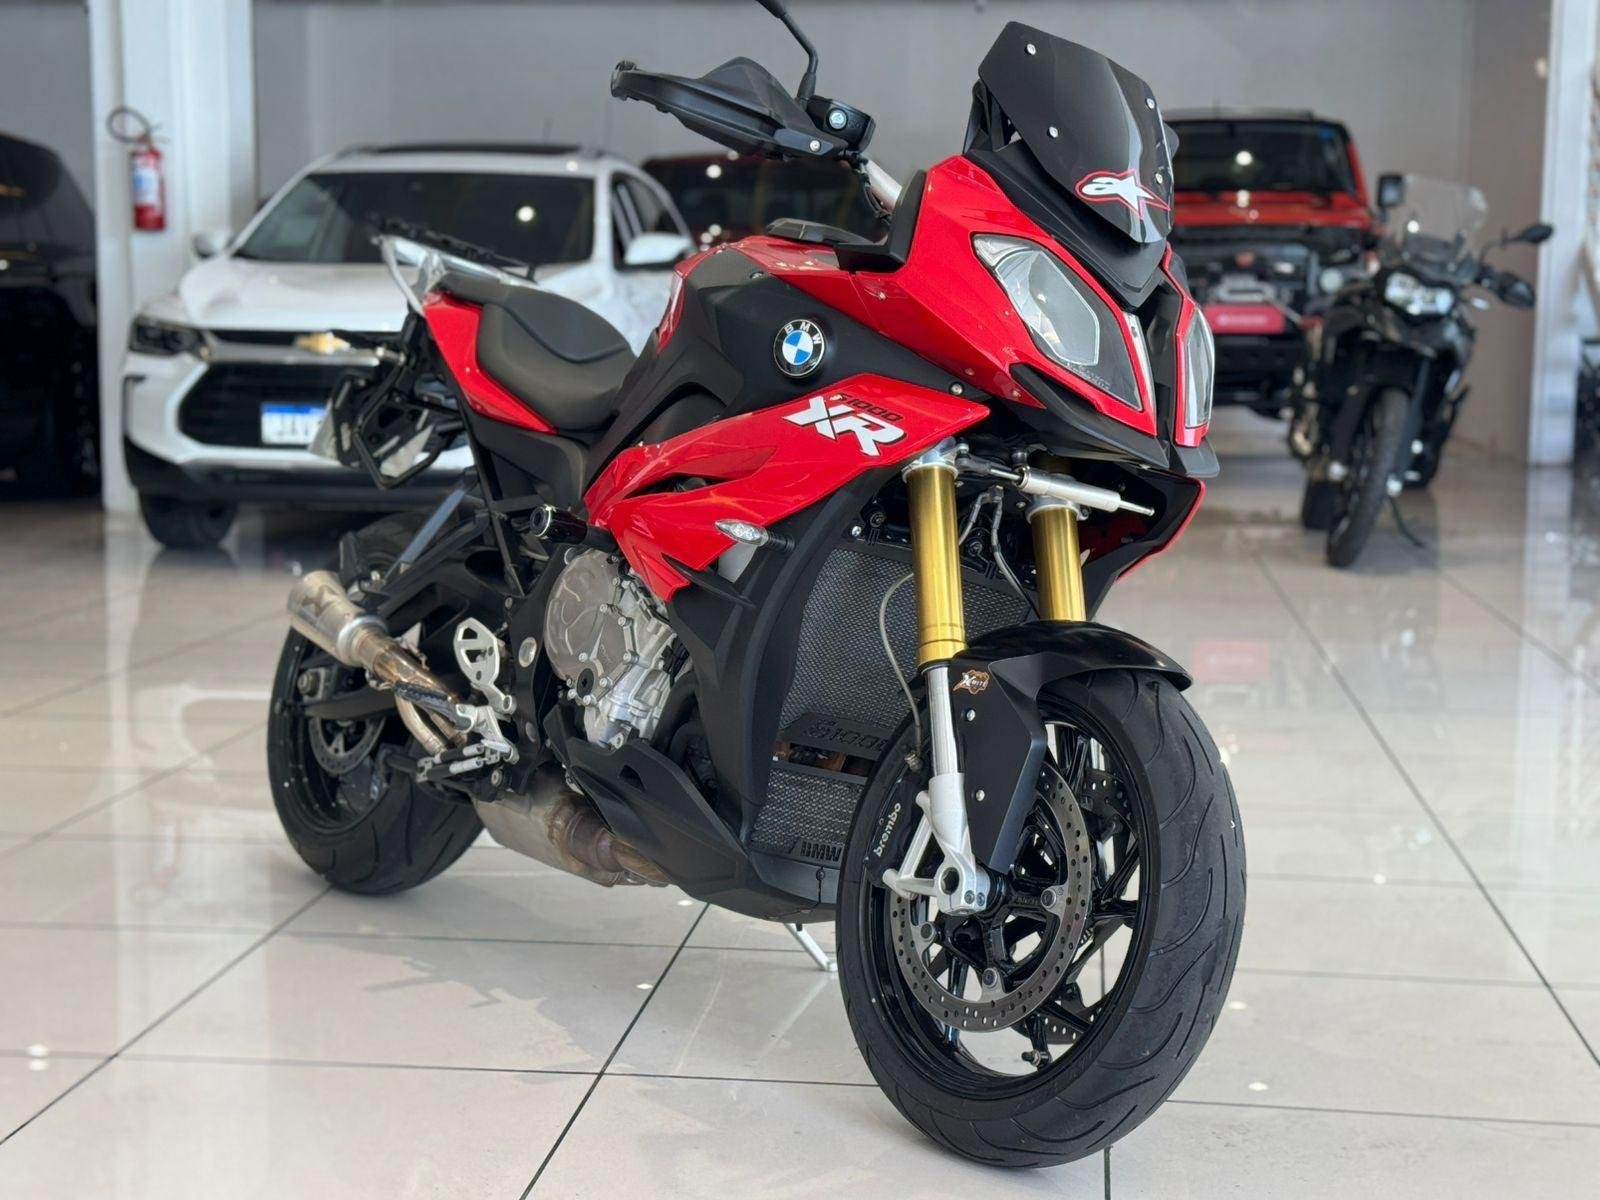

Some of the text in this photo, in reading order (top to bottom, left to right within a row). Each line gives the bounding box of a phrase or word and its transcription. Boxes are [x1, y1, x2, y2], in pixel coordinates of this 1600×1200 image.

[784, 321, 822, 345] BMW
[781, 396, 907, 456] XR
[873, 802, 902, 857] brembo
